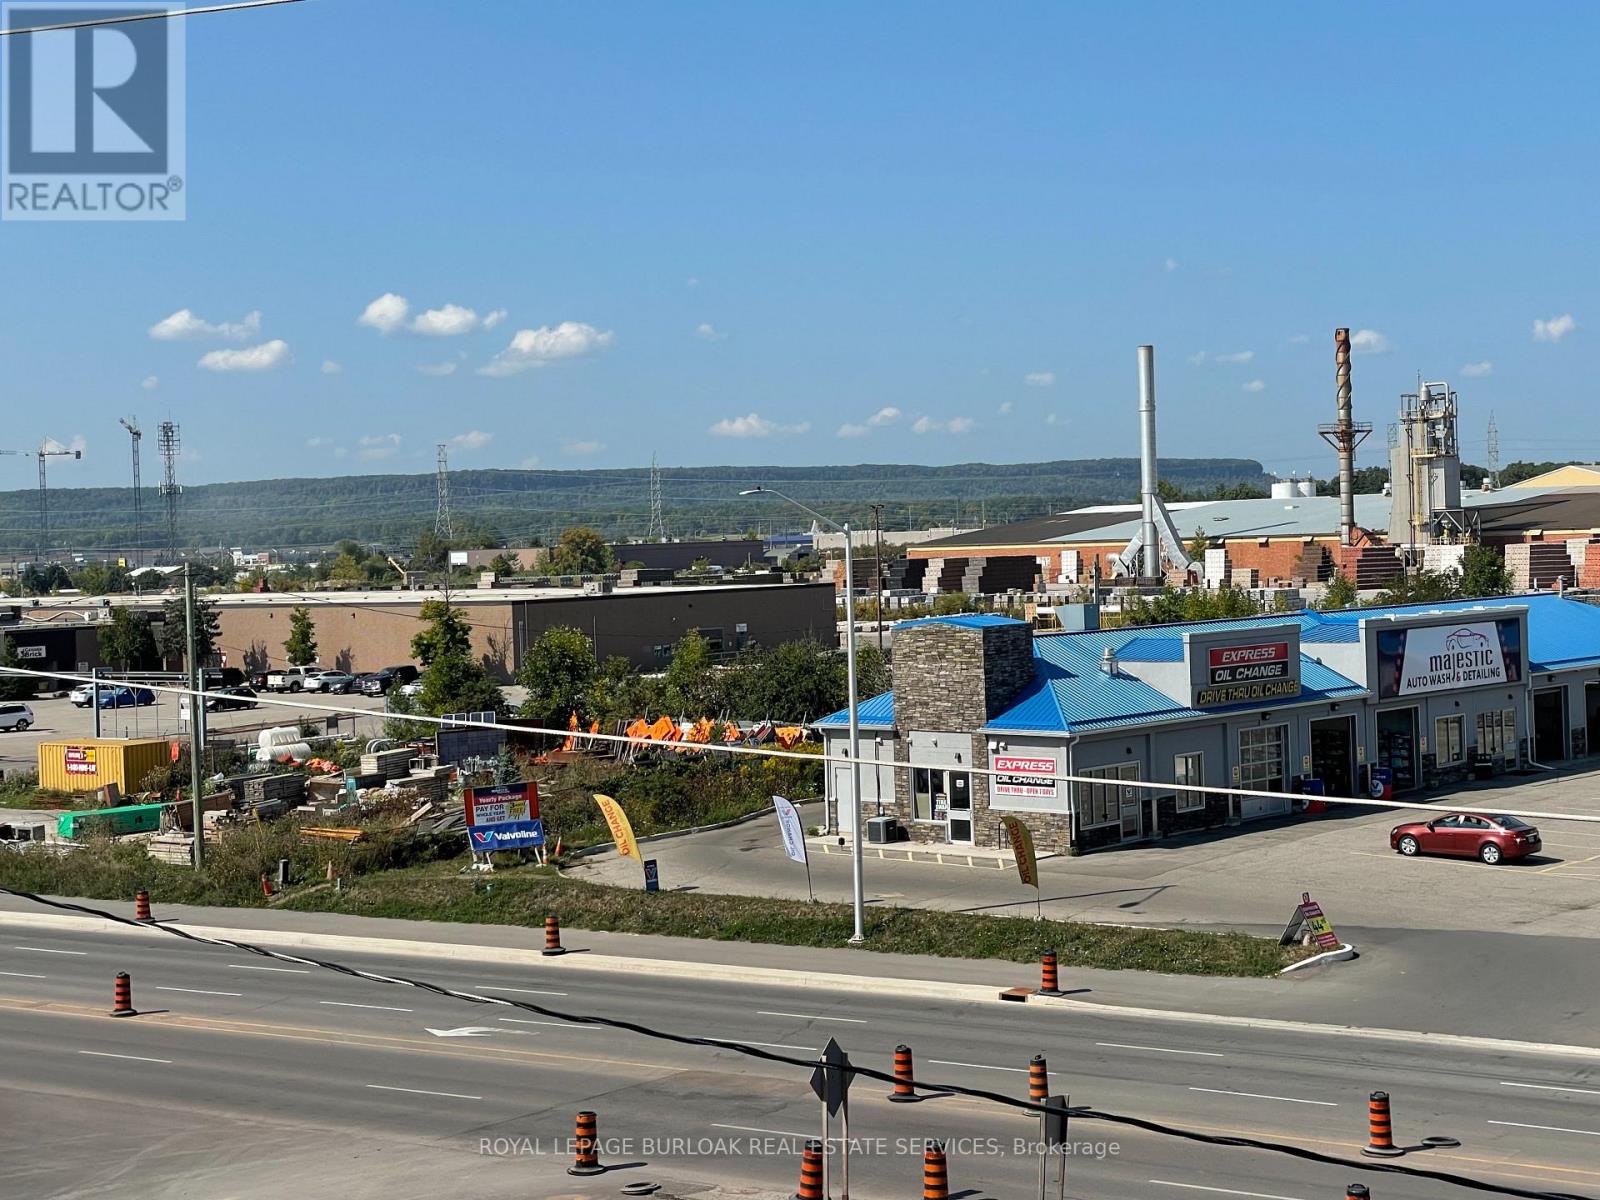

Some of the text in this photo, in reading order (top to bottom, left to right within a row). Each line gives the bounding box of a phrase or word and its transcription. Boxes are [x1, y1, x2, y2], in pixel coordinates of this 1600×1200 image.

[1222, 647, 1276, 662] EXPRESS
[1215, 664, 1283, 681] OIL CHANGE
[1406, 676, 1428, 689] AUTO
[1429, 673, 1451, 686] WASH
[1463, 667, 1500, 681] DETAILING
[1199, 680, 1299, 704] DRIVE THRU OIL CHANGE
[996, 760, 1054, 771] EXPRESS
[996, 775, 1054, 785] OIL CHANGE
[996, 786, 1010, 794] DRIVE
[1011, 786, 1024, 794] THRU
[1027, 787, 1038, 795] OPEN
[1042, 788, 1055, 796] DAYS
[478, 794, 522, 804] Yearly Package
[494, 830, 538, 841] Valvoline
[602, 800, 630, 856] OIL CHANGE
[1009, 821, 1031, 883] OIL CHANGE
